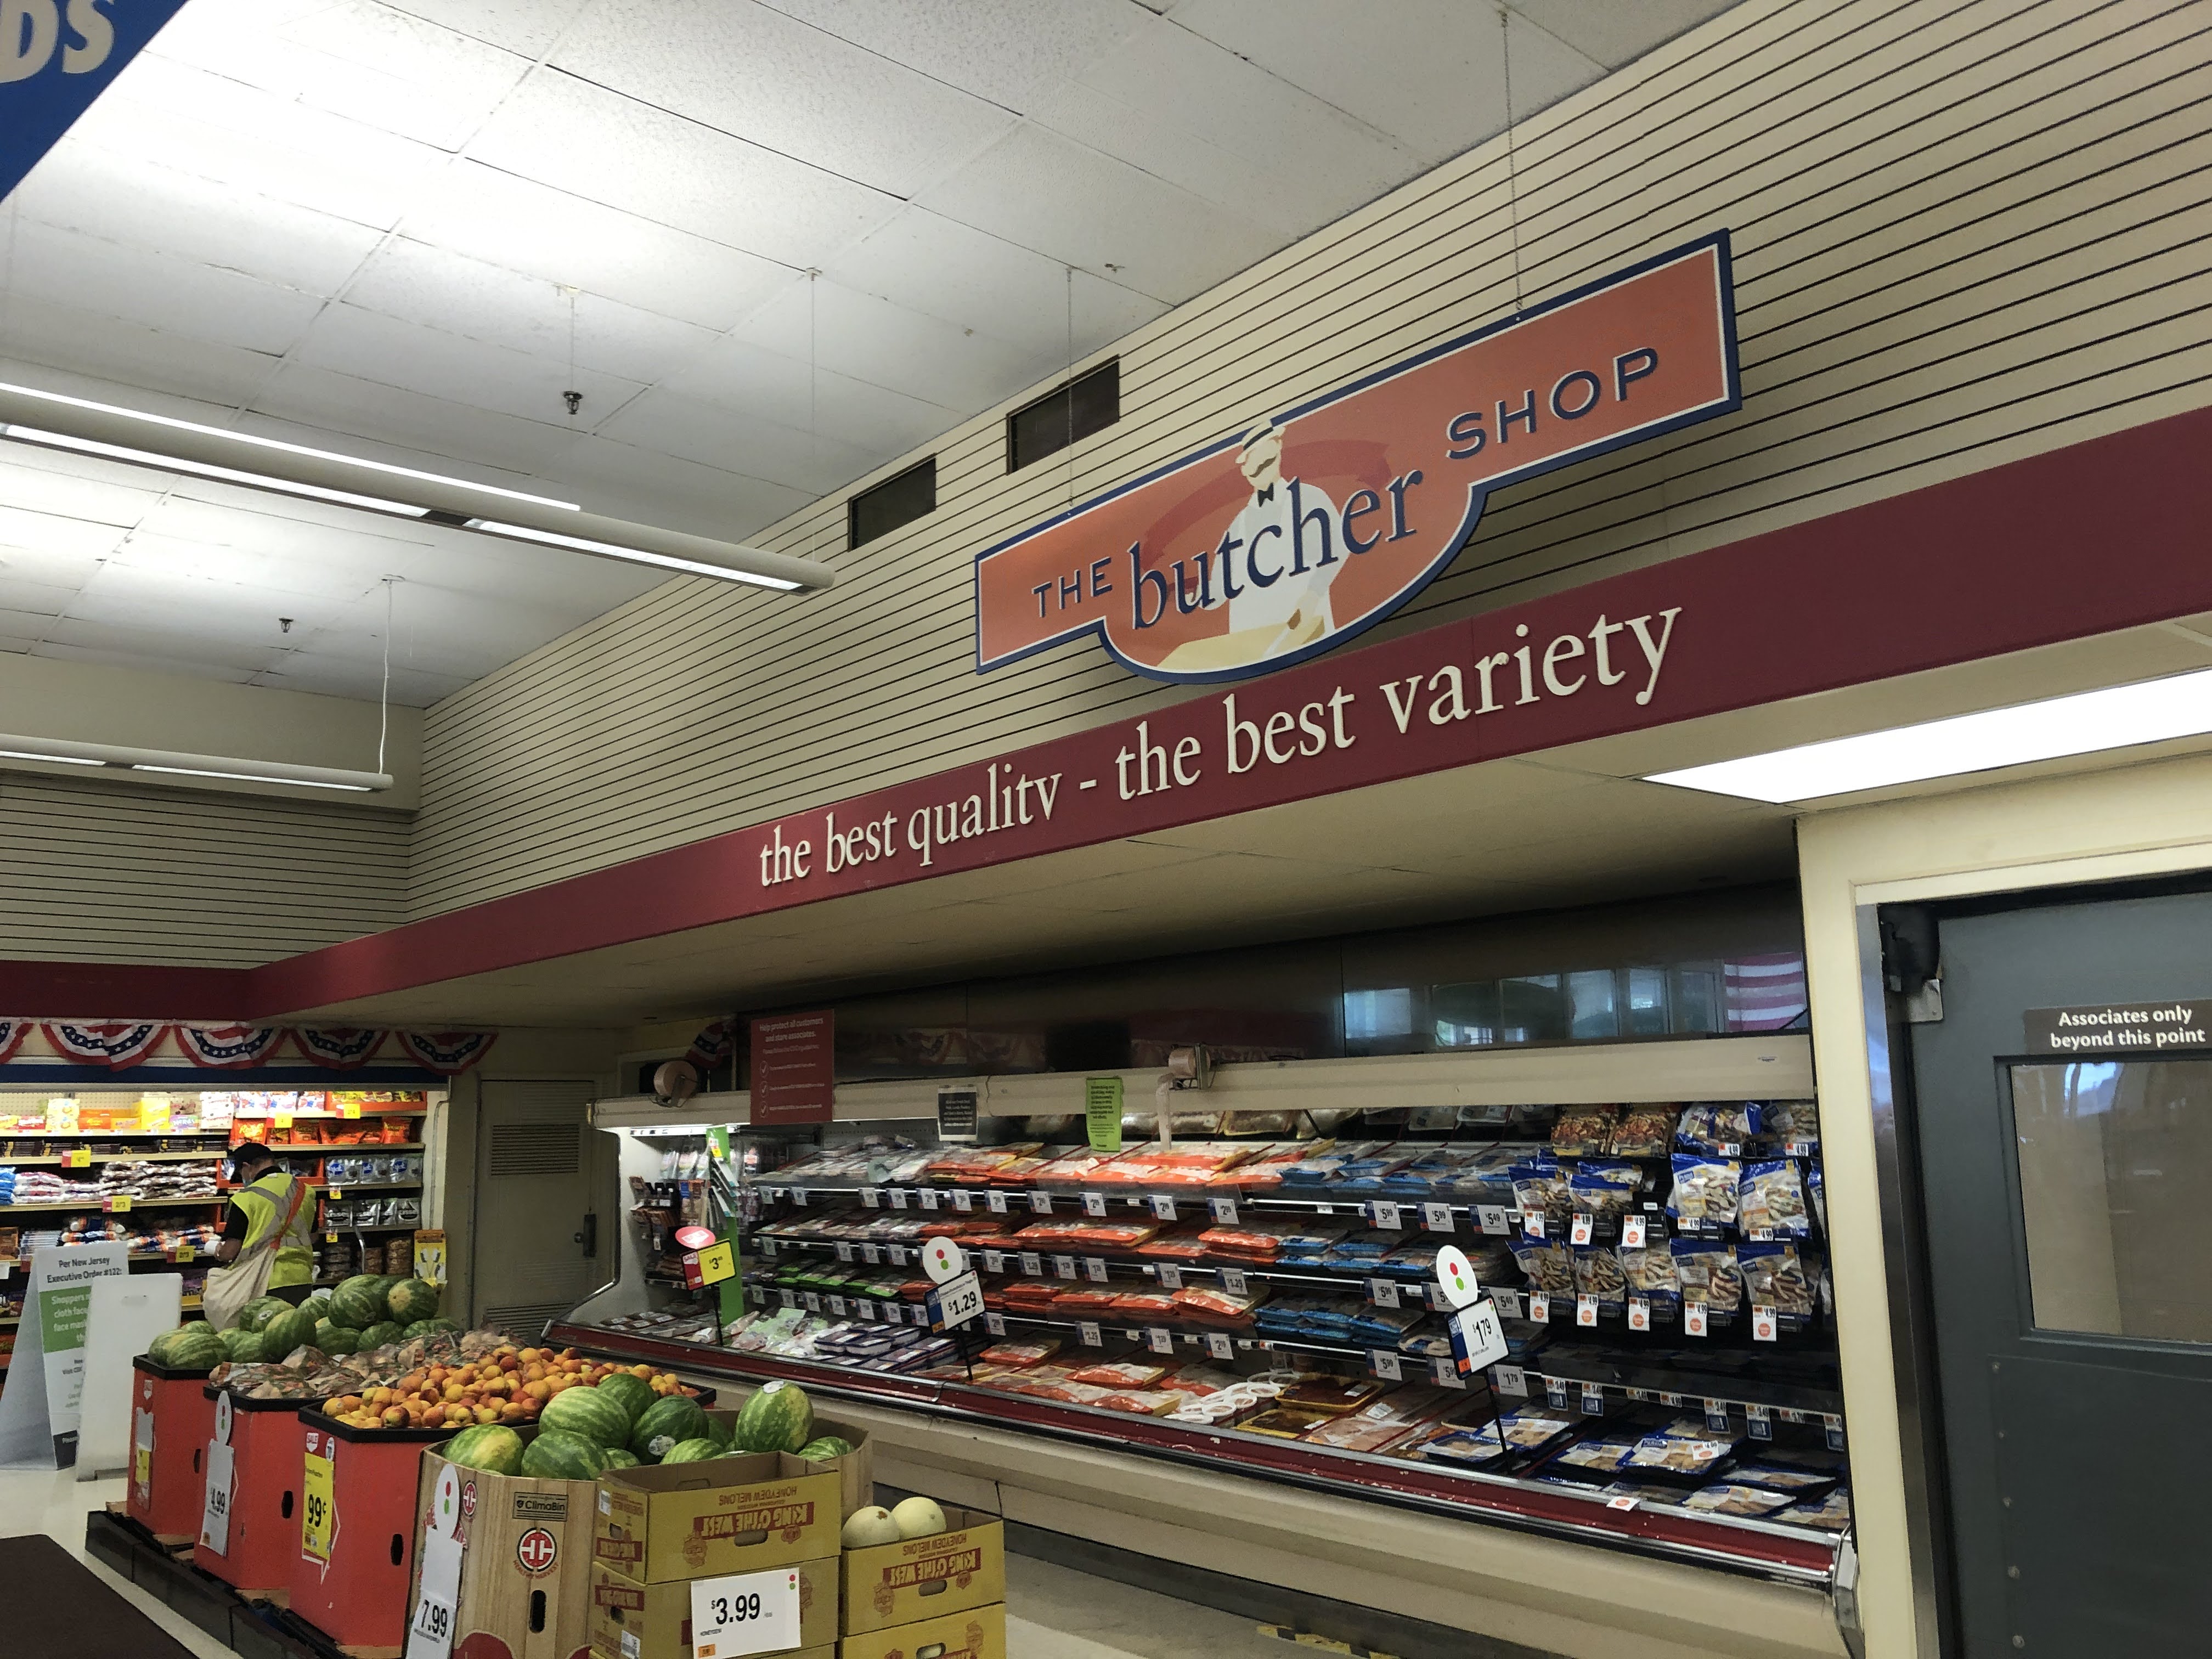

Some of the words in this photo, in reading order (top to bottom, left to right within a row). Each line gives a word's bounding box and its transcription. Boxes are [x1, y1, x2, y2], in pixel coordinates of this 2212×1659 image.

[1032, 557, 1113, 618] THE
[1128, 469, 1423, 630] butcher
[1446, 347, 1659, 460] SHOP
[759, 825, 811, 887] the
[826, 812, 898, 873] best
[1115, 720, 1201, 802] the
[1226, 686, 1356, 775] best
[1379, 607, 1683, 736] variety
[2059, 1009, 2149, 1026] Associates
[2153, 1005, 2192, 1025] only
[2050, 1030, 2114, 1051] beyond
[2118, 1029, 2152, 1046] this
[2156, 1027, 2206, 1048] point
[58, 1260, 71, 1268] Per
[88, 1257, 110, 1266] Jersey
[47, 1272, 82, 1283] Executive
[83, 1269, 103, 1279] Order
[948, 1291, 977, 1316] $1.29
[526, 1500, 565, 1511] ClimaBin
[719, 1492, 752, 1506] MELONS
[773, 1504, 808, 1527] KING
[711, 1593, 760, 1624] $3.99
